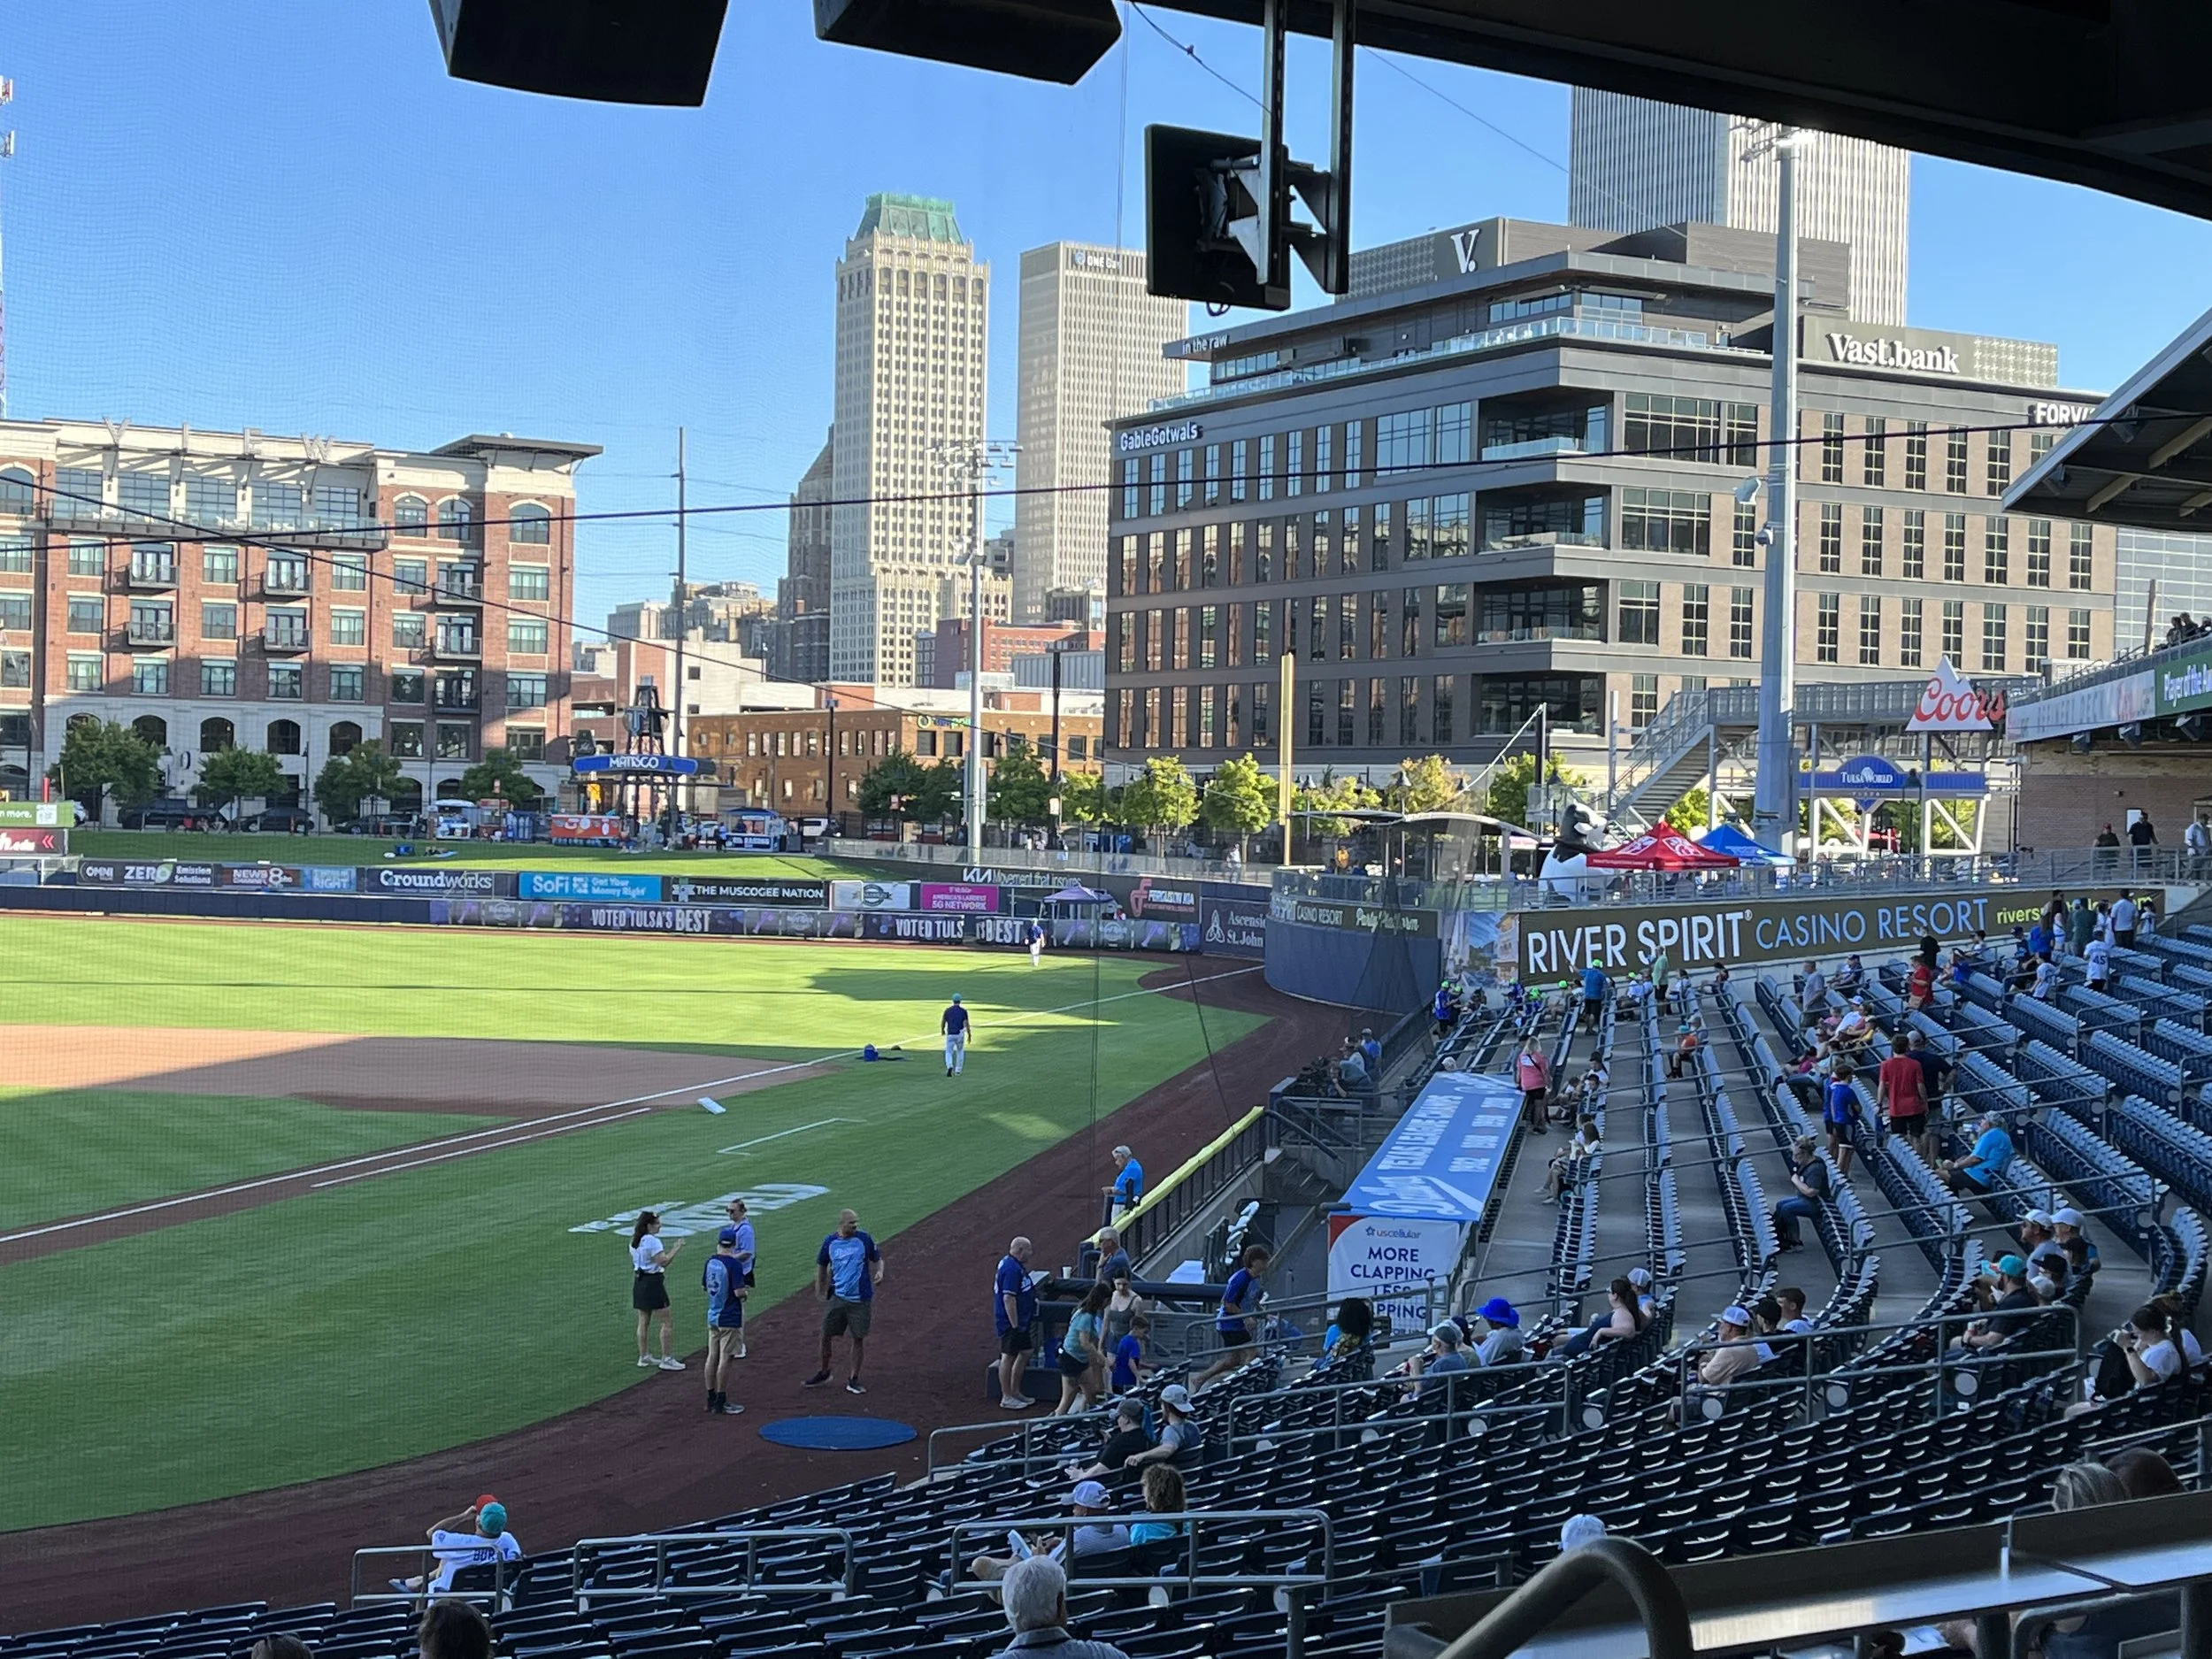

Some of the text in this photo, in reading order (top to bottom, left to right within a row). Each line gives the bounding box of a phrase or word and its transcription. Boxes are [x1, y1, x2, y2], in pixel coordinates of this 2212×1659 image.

[1182, 334, 1228, 355] in the raw
[1830, 333, 1960, 373] Vast.bank
[1120, 421, 1198, 451] GableGotwals
[1914, 677, 2007, 722] Coors
[380, 870, 493, 889] Groundworks
[533, 875, 569, 894] SoFi
[696, 886, 824, 898] THE MUSCOGEE NATION
[944, 901, 987, 910] NETWORK
[591, 909, 712, 933] VOTED TULSA'S BEST
[895, 918, 933, 938] VOTED
[1240, 931, 1264, 949] John
[1527, 923, 1627, 973] RIVER
[1755, 910, 1866, 949] CASINO
[1878, 897, 1989, 940] RESORT
[1368, 1247, 1419, 1262] MORE
[1350, 1264, 1435, 1280] CLAPPING
